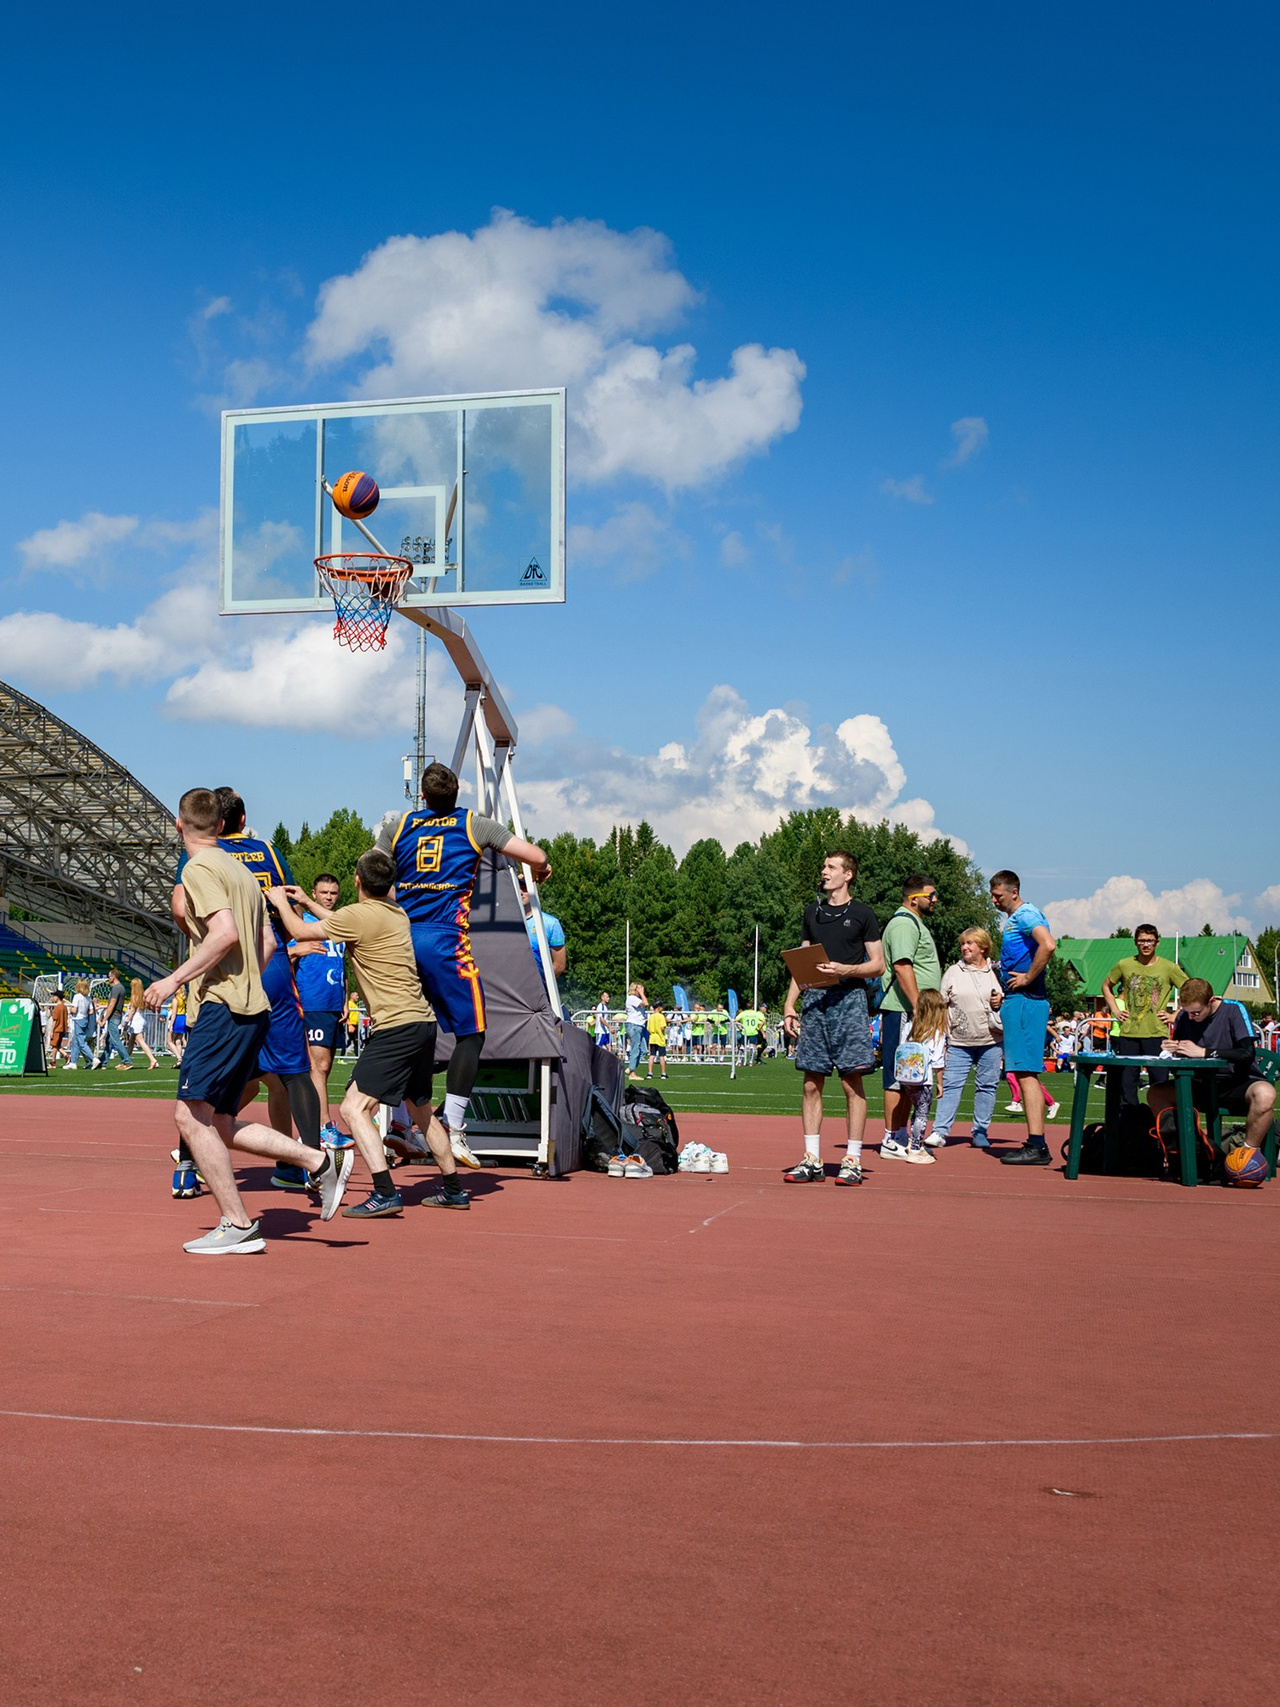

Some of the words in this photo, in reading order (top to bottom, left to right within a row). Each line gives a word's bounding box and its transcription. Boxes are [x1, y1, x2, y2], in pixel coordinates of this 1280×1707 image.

[416, 835, 444, 872] 8
[746, 1018, 756, 1027] 10
[307, 1028, 324, 1041] 10
